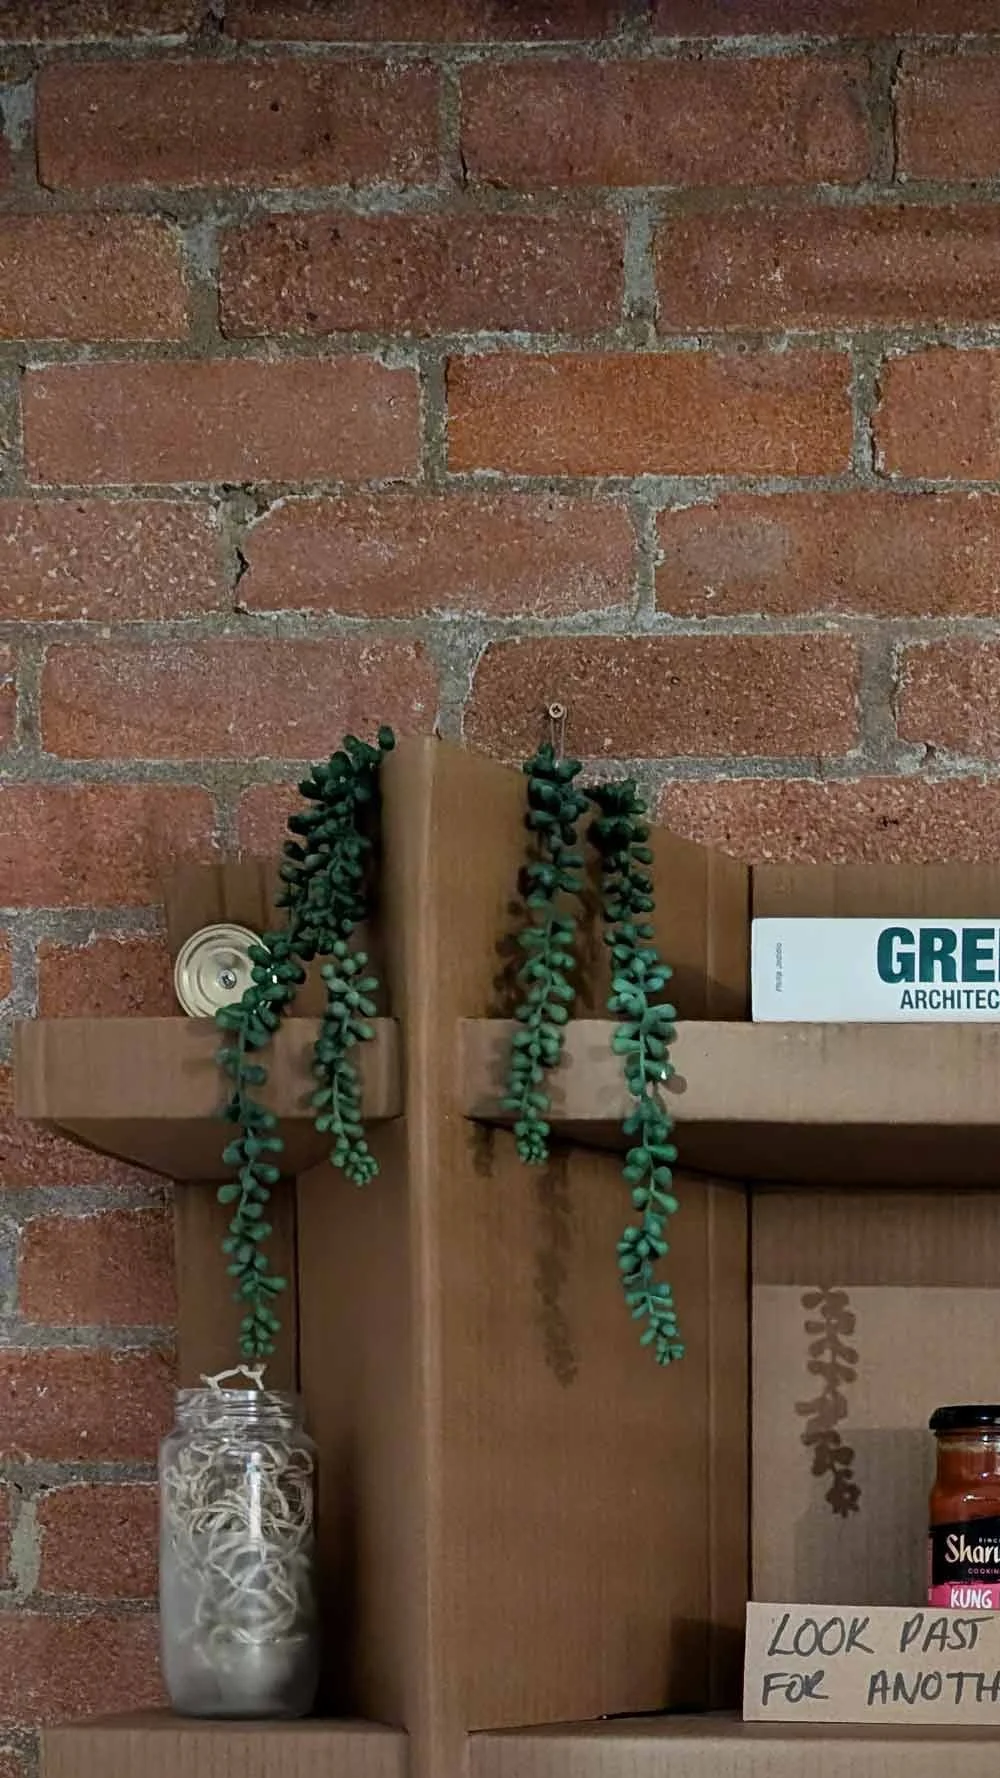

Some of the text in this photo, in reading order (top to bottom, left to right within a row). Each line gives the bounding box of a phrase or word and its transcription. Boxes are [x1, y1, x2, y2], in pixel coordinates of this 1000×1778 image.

[950, 1588, 993, 1609] KUNG
[767, 1613, 875, 1657] LOOK
[899, 1613, 994, 1654] PAST
[762, 1669, 829, 1706] FOR
